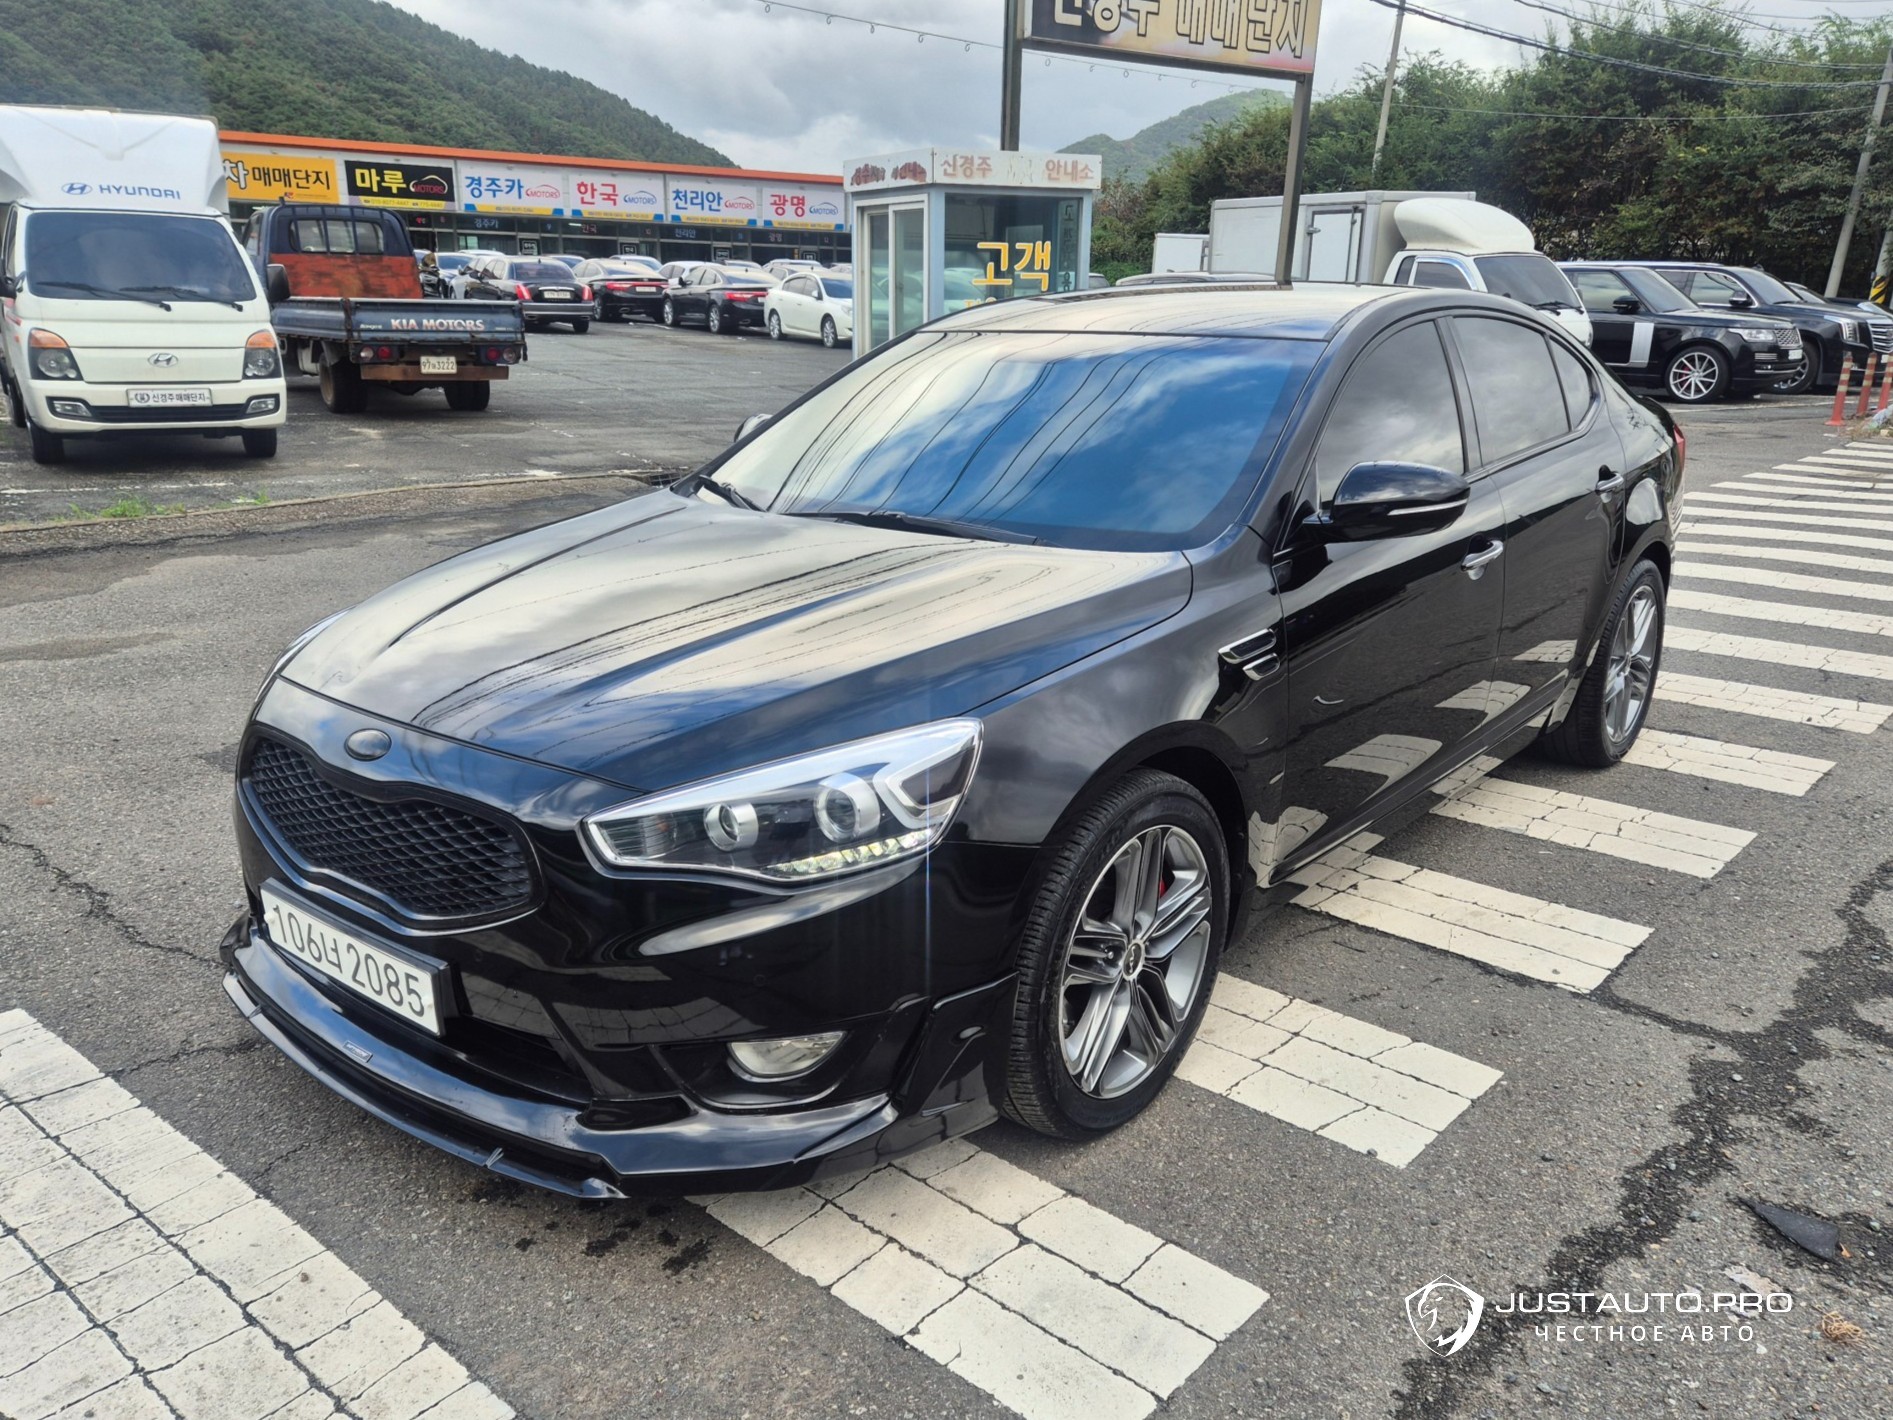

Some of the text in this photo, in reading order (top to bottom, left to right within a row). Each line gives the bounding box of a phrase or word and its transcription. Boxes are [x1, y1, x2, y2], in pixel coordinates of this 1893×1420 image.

[251, 166, 331, 191] 매매단지
[940, 153, 993, 178] 신경주
[1045, 158, 1094, 182] 안내소
[98, 184, 181, 200] HYUNDAI
[355, 168, 407, 194] 마루
[413, 184, 445, 195] MOTORS
[465, 175, 524, 200] 경주카
[529, 189, 559, 199] MOTORS
[576, 181, 619, 206] 한국
[626, 196, 656, 206] MOTORS
[672, 188, 723, 213] 천리안
[728, 202, 754, 211] MOTORS
[770, 194, 806, 218] 광명
[812, 207, 839, 216] MOTORS
[972, 240, 1052, 292] 고객
[390, 318, 486, 331] KIA MOTORS
[151, 392, 206, 403] 신경주 매매단지
[272, 904, 425, 1018] 106너2085
